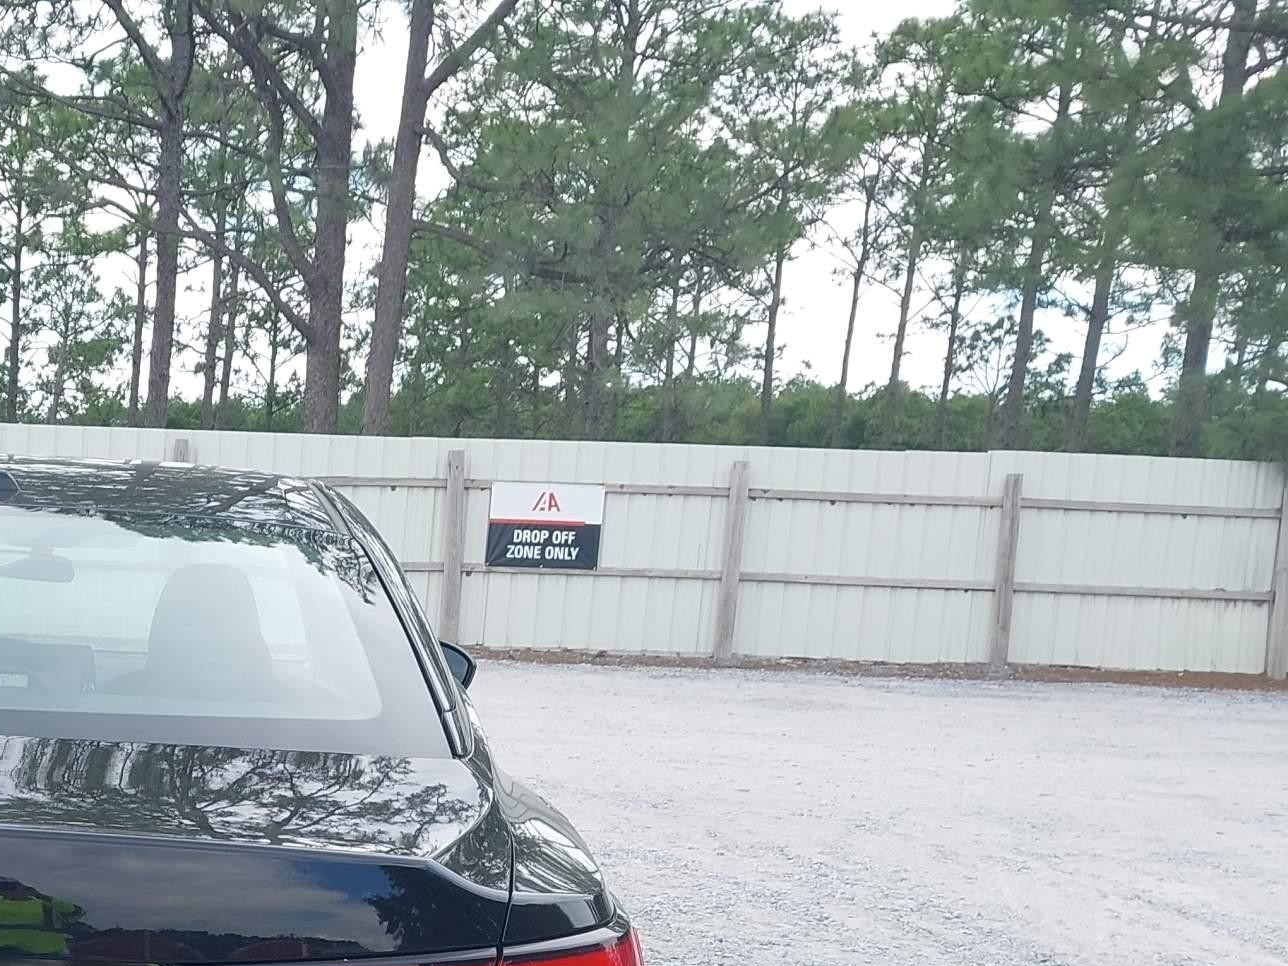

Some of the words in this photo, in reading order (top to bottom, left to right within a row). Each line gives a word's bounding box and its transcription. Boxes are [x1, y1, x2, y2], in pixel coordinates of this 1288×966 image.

[513, 529, 549, 543] DROP
[552, 530, 576, 545] OFF
[506, 545, 541, 559] ZONE
[545, 546, 579, 560] ONLY
